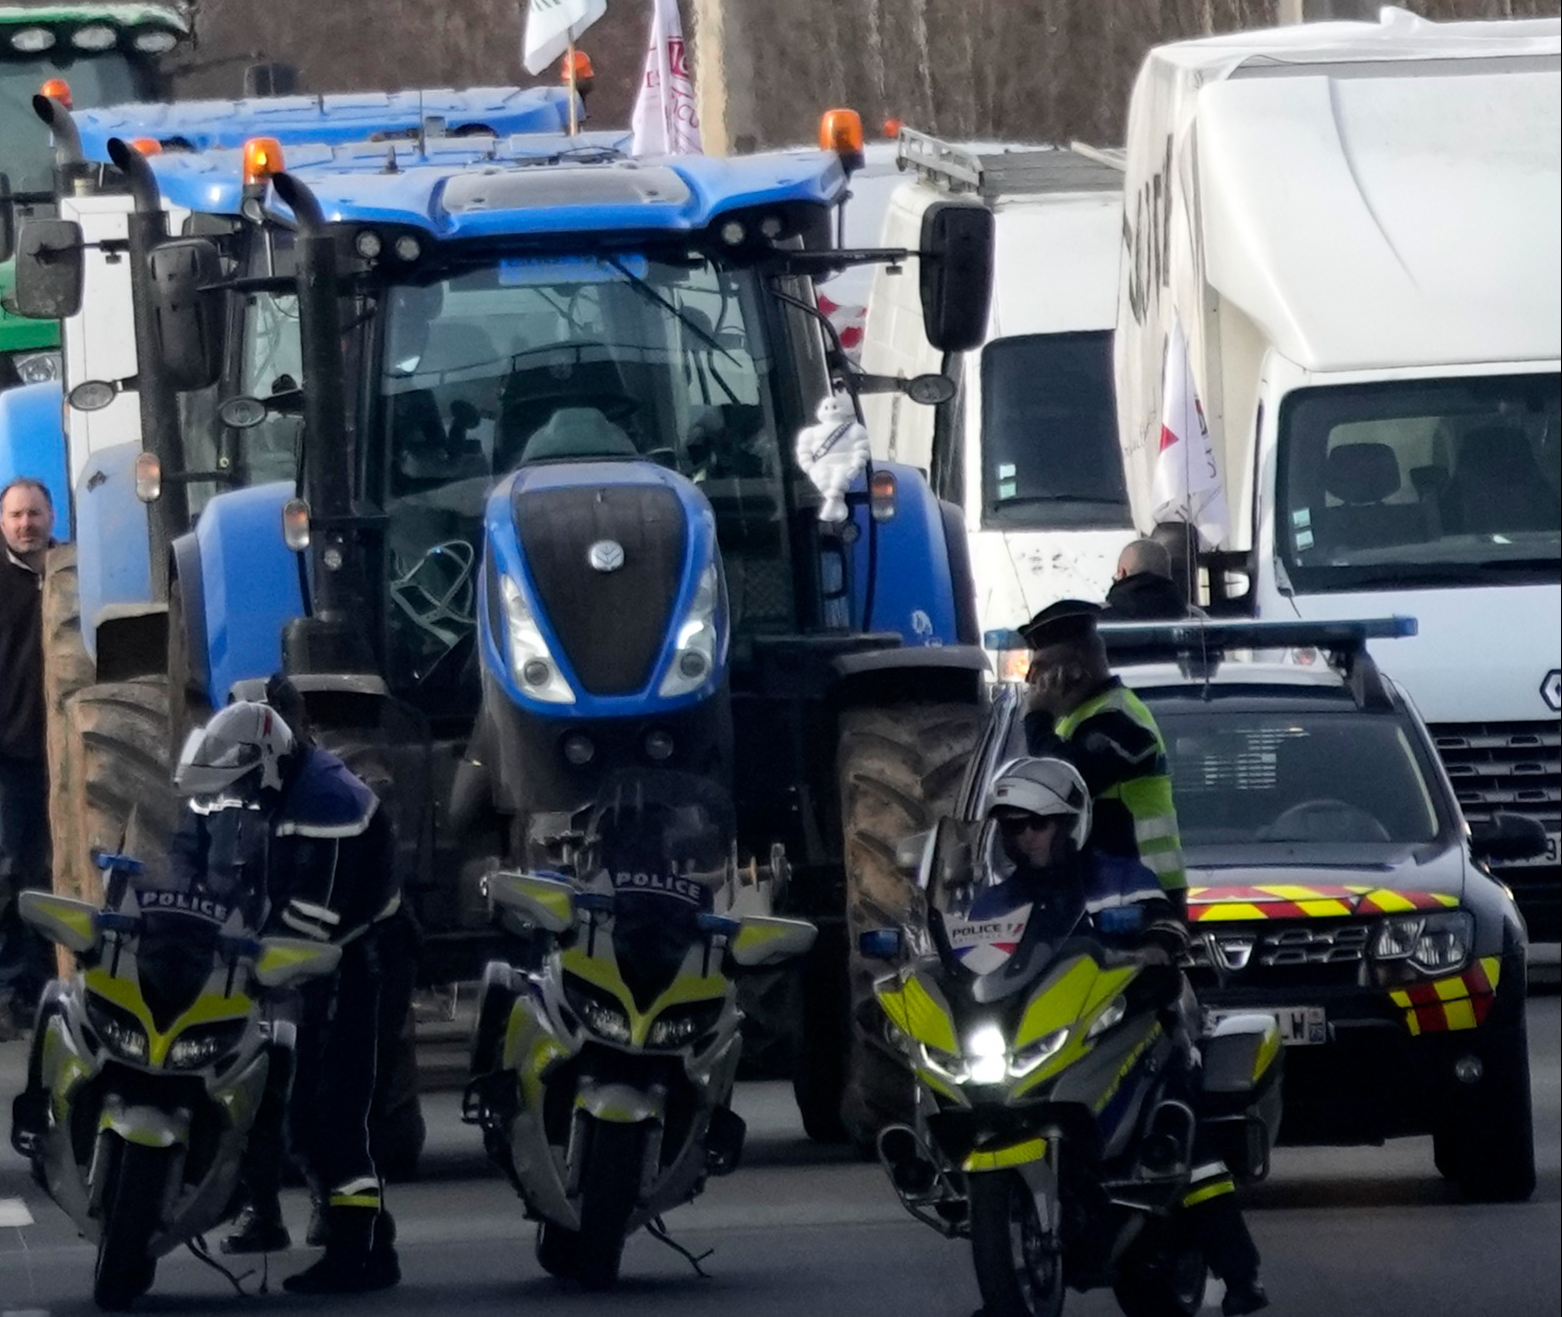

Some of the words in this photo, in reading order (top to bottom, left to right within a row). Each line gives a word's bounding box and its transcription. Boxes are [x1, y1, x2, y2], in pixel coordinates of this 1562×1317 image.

[616, 871, 700, 900] POLICE
[142, 891, 227, 921] POLICE
[952, 923, 1002, 939] POLICE
